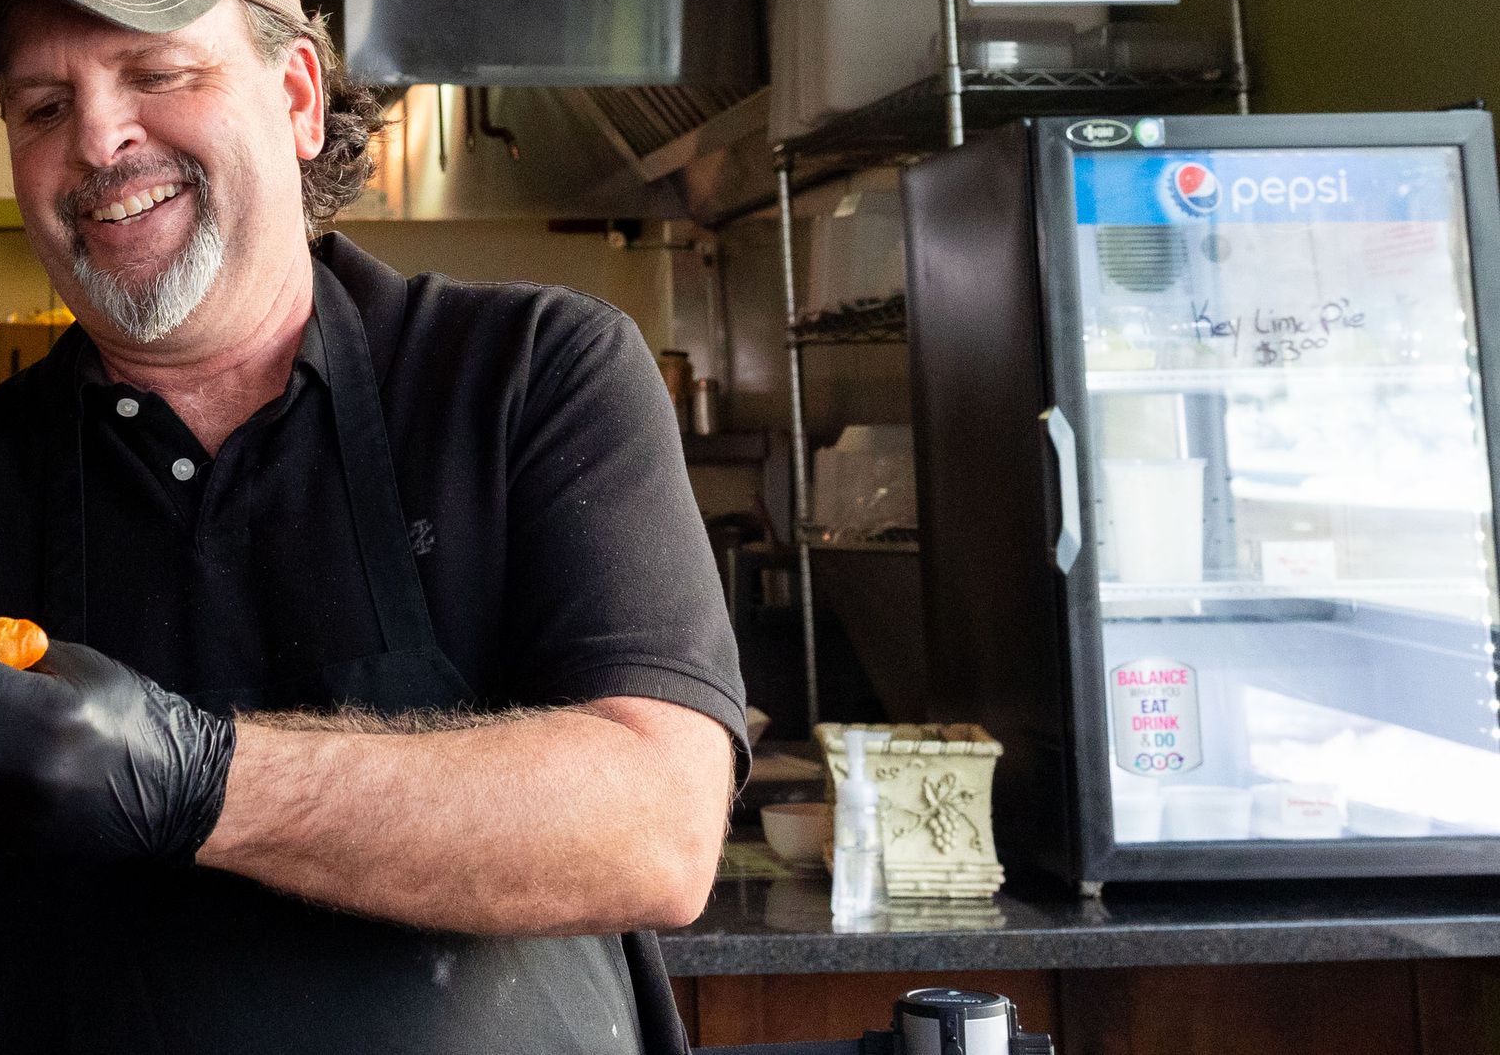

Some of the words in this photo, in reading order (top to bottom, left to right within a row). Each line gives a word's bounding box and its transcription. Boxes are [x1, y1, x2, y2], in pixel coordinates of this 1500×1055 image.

[1231, 168, 1350, 212] pepsi
[1191, 299, 1242, 357] Key
[1319, 298, 1366, 335] Pie
[1116, 669, 1189, 687] BALANCE
[1140, 699, 1168, 714] EAT
[1131, 715, 1180, 732] DRINK
[1154, 733, 1176, 748] DO
